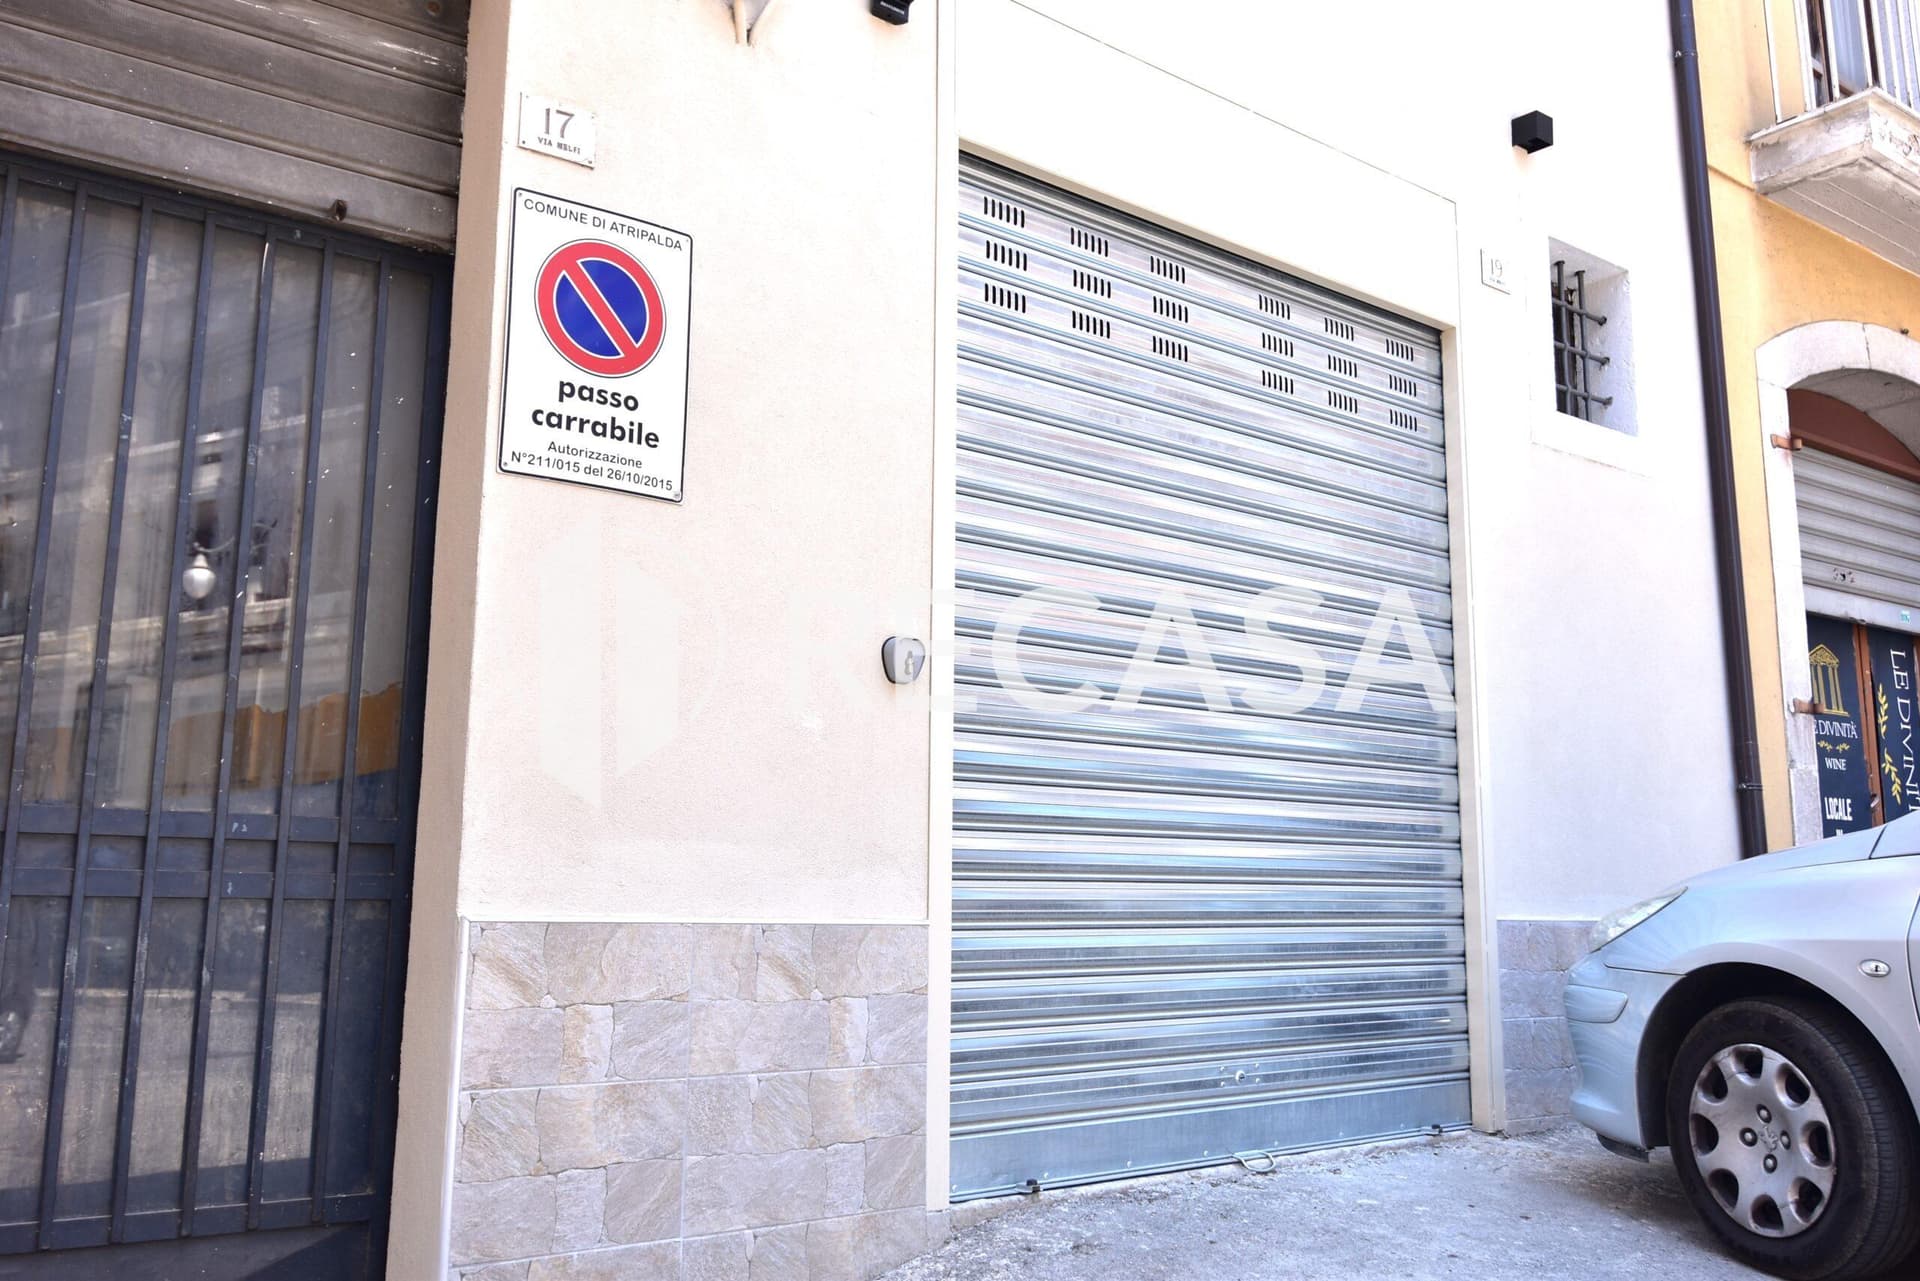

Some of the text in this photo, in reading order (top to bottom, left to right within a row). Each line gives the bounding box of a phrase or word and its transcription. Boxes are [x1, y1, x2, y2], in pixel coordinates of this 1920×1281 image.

[544, 107, 575, 139] 17
[537, 136, 553, 147] VIA
[523, 198, 683, 252] COMUNE DI ATRIPALDA
[1490, 258, 1503, 278] 19
[558, 380, 639, 411] passo
[531, 408, 660, 449] carrabile
[511, 450, 673, 491] N°211/015 del 26/10/2015
[548, 441, 643, 469] Autorizzazione
[1890, 649, 1909, 690] LE
[1824, 757, 1847, 771] WINE
[1824, 797, 1853, 821] LOCALE
